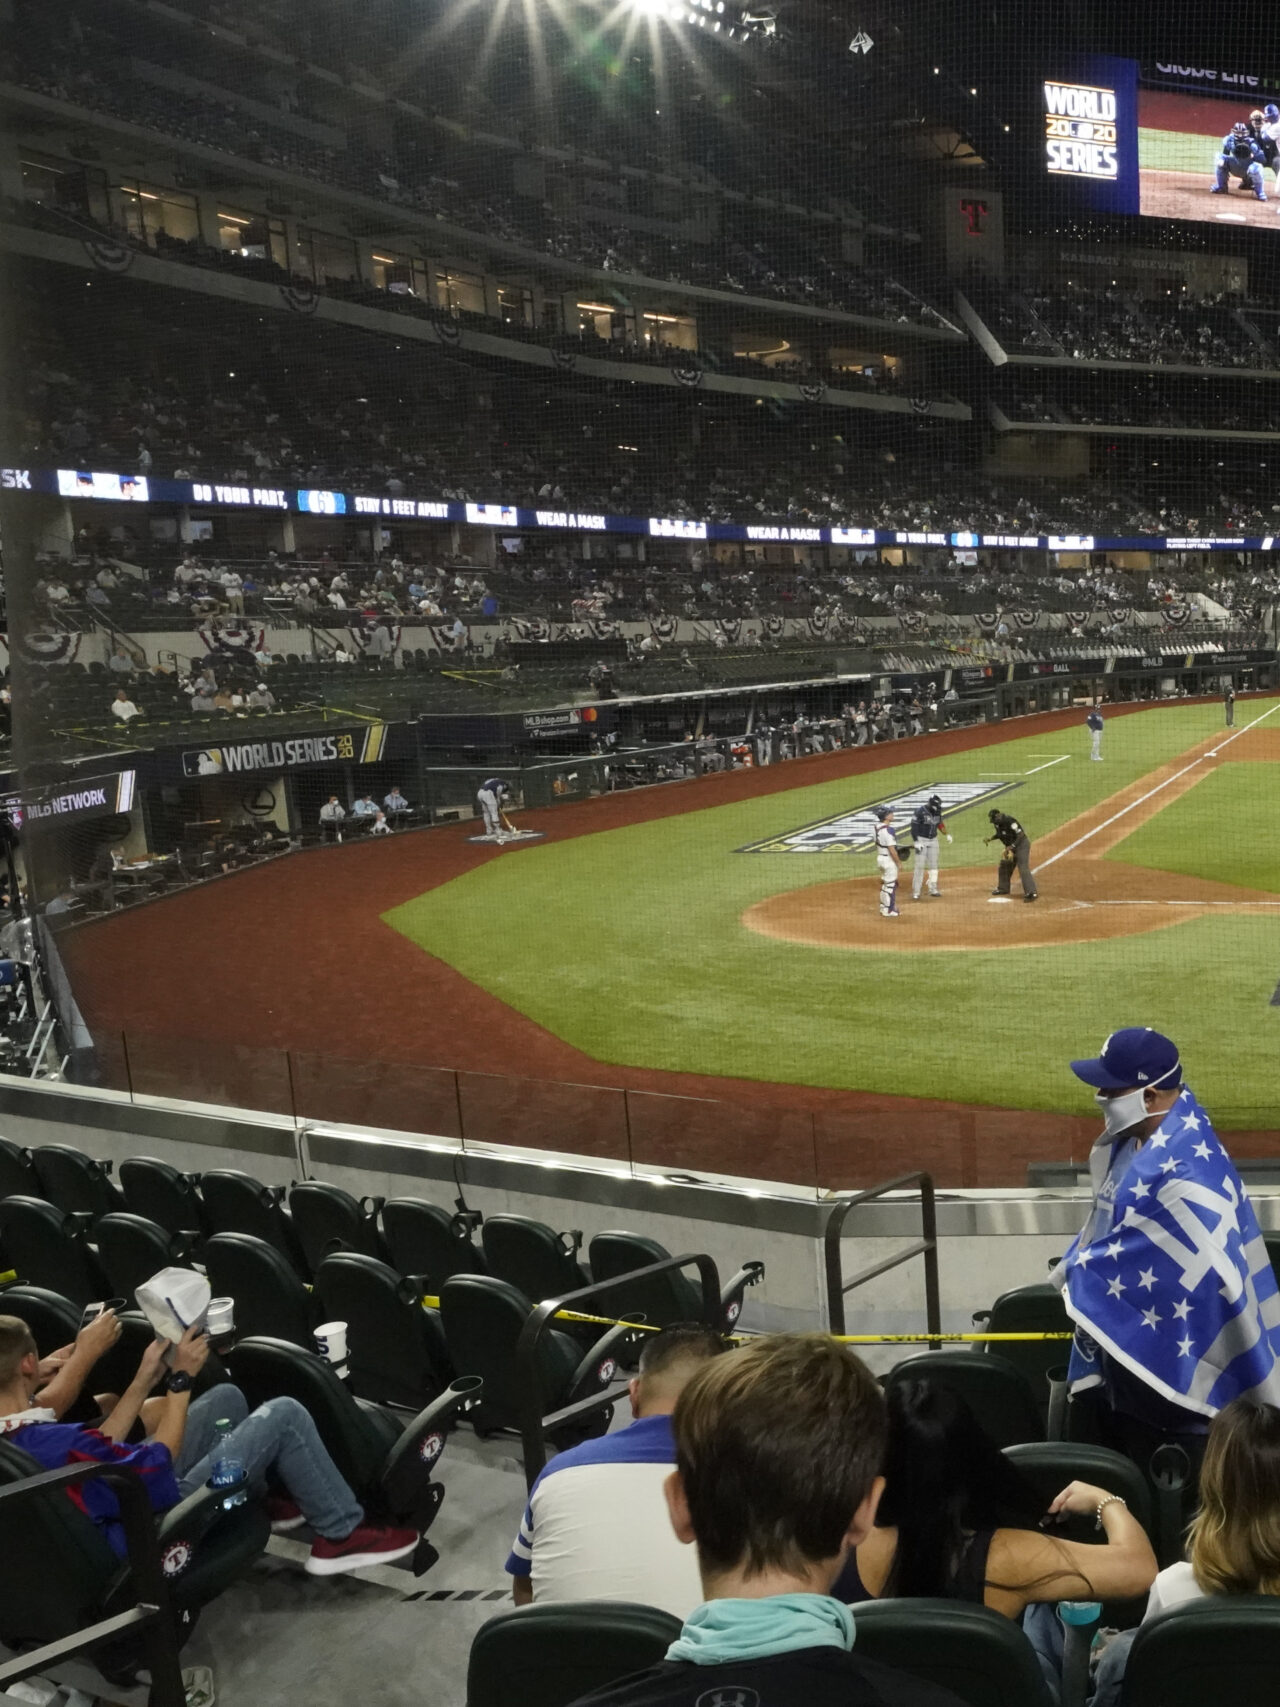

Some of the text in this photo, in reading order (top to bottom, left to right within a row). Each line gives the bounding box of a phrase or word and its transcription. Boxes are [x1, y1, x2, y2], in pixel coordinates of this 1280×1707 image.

[1044, 85, 1116, 121] WORLD
[1046, 139, 1117, 175] SERIES
[192, 484, 289, 510] DO YOUR PART,
[354, 496, 449, 518] STAY 6 FEET APART
[536, 510, 607, 529] WEAR A MASK
[746, 526, 821, 541] WEAR A MASK
[337, 735, 353, 747] 20
[222, 736, 338, 773] WORLD SERIES
[337, 746, 354, 759] 20
[52, 788, 106, 814] NETWORK
[432, 1490, 440, 1502] 3
[182, 1609, 190, 1623] 4
